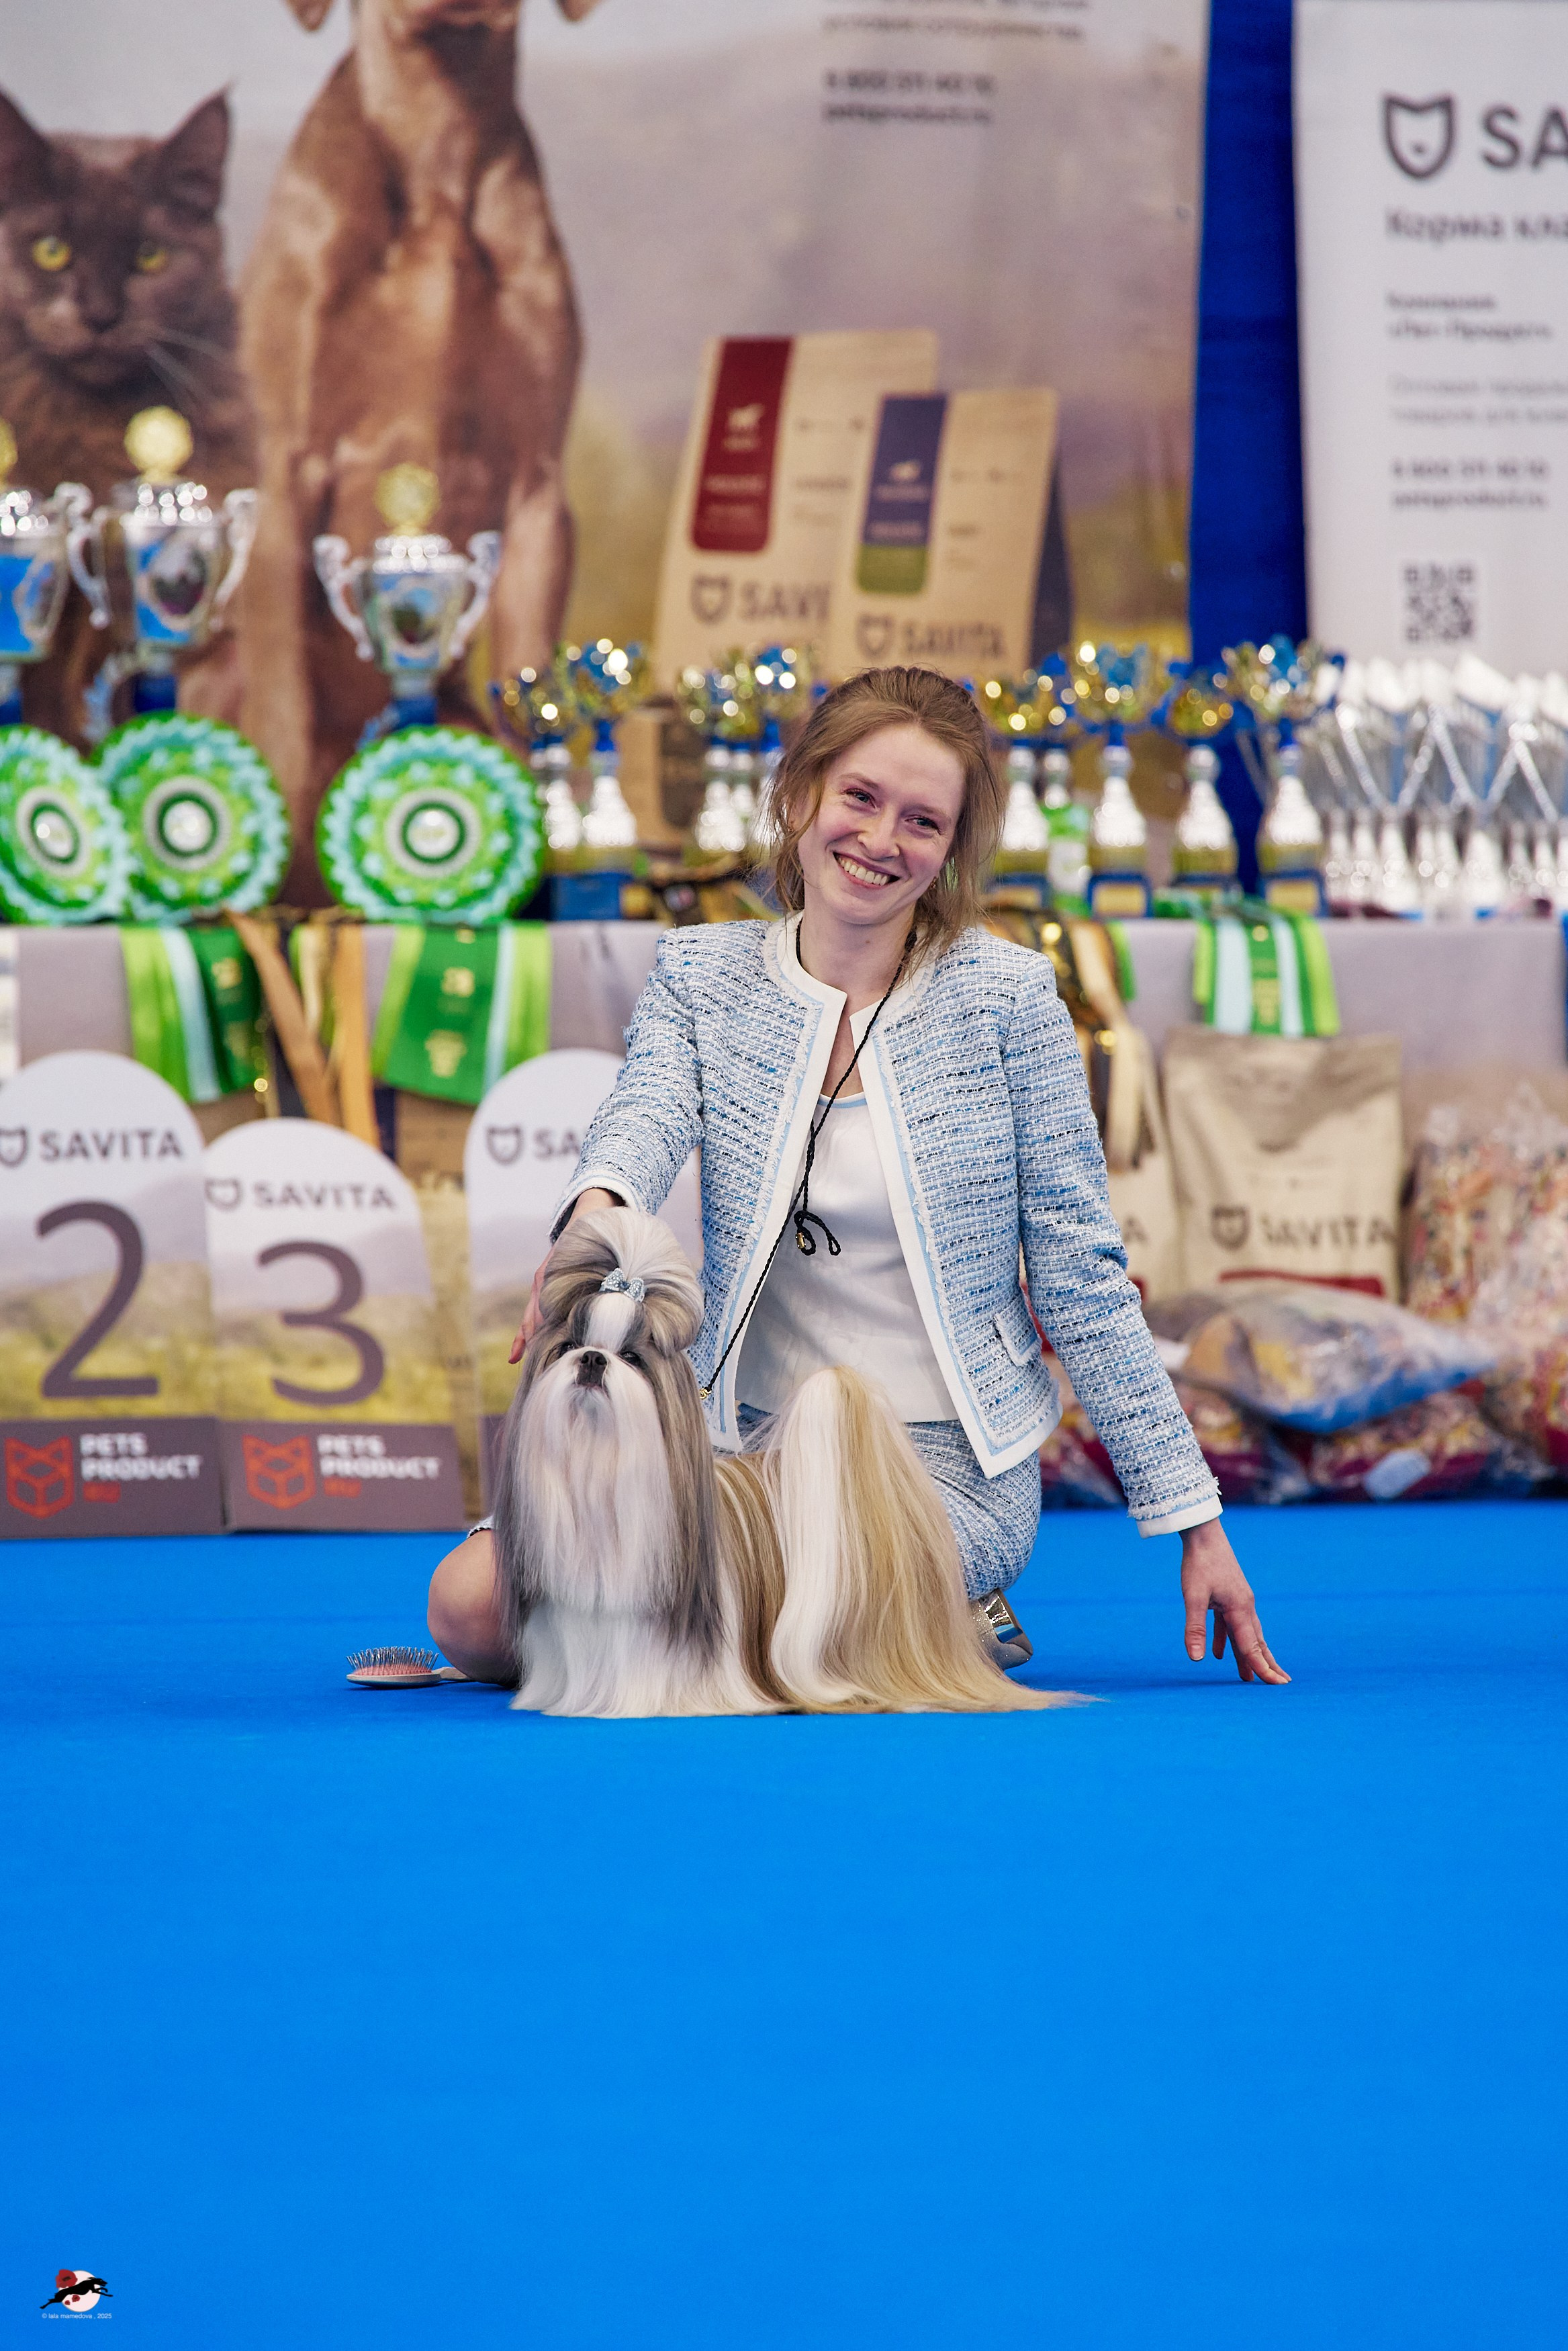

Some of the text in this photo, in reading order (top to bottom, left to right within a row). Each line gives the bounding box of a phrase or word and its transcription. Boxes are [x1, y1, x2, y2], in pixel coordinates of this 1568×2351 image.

[1481, 104, 1568, 170] SA
[1385, 210, 1504, 245] Корма
[40, 1126, 183, 1162] SAVITA
[255, 1180, 396, 1210] SAVITA
[36, 1200, 160, 1399] 2
[257, 1240, 387, 1408] 3
[80, 1431, 148, 1457] PETS
[318, 1433, 385, 1458] PETS
[81, 1454, 201, 1481] PRODUCT
[320, 1456, 441, 1480] PRODUCT
